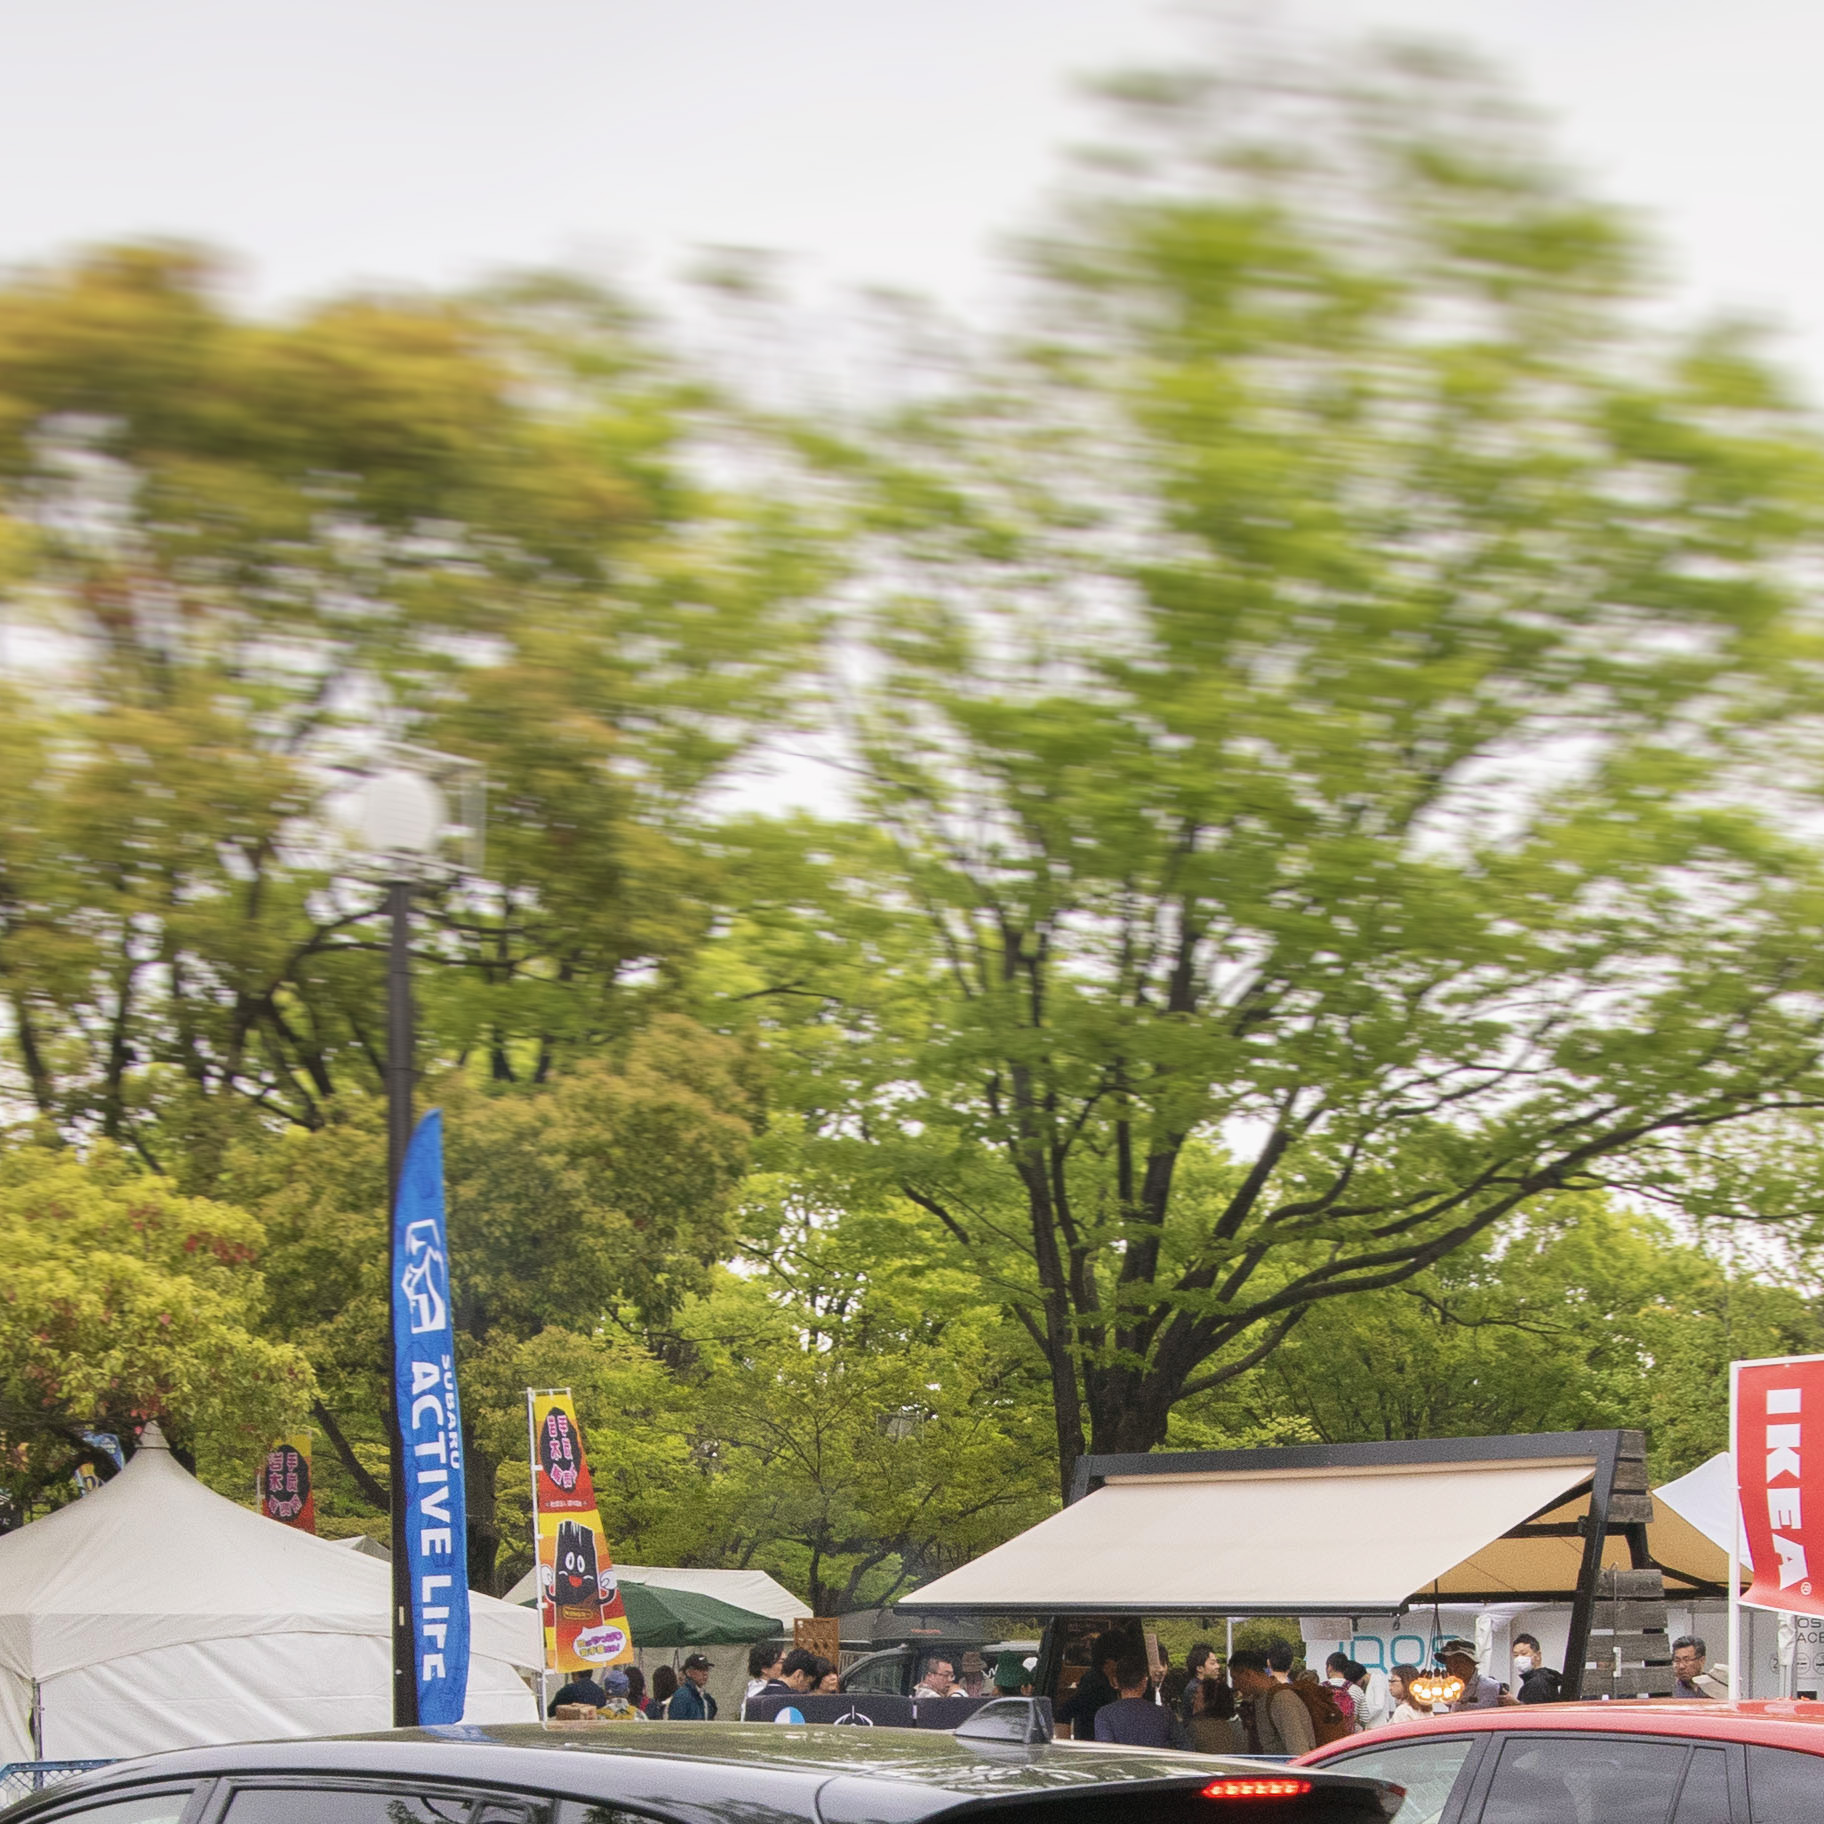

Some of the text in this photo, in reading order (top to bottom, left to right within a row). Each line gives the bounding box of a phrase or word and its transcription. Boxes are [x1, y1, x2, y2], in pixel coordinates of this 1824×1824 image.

[441, 1355, 460, 1469] SUBARU
[1766, 1388, 1809, 1591] IKEA
[411, 1361, 452, 1681] ACTIVE LIFE
[1797, 1617, 1822, 1629] OS
